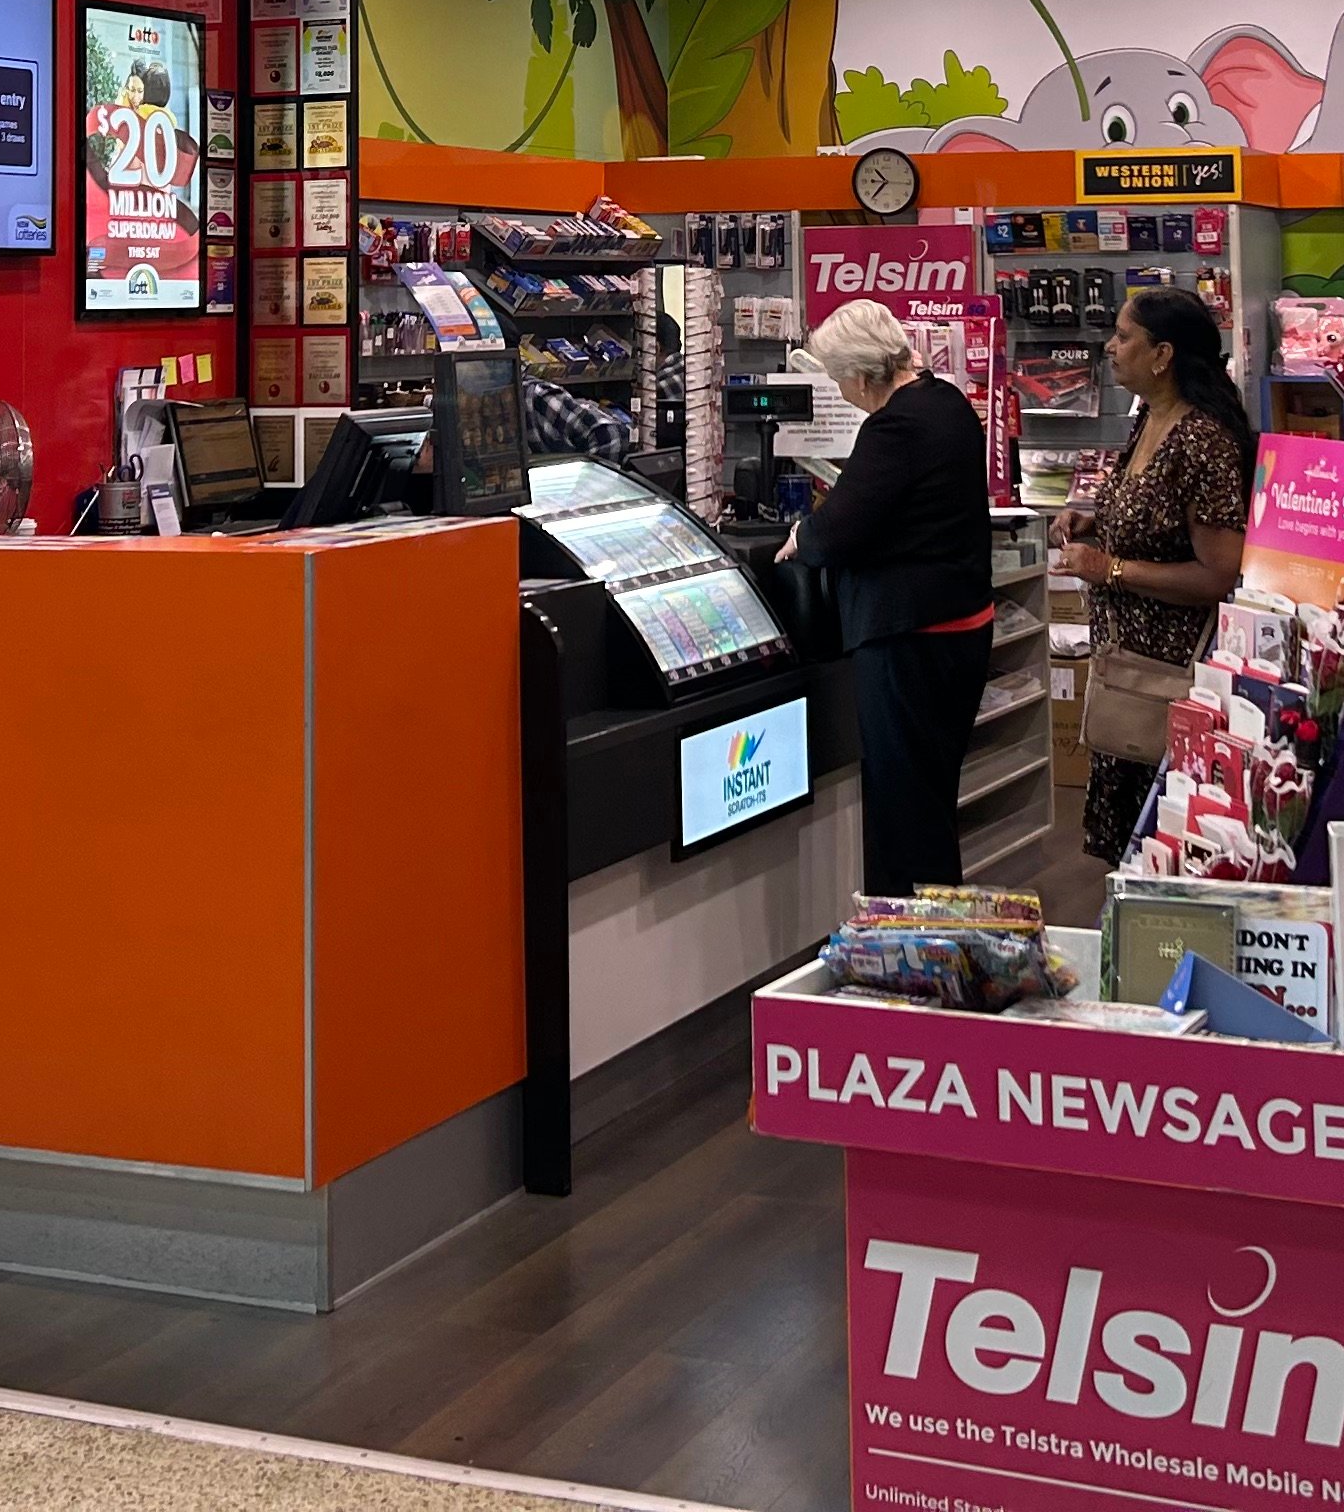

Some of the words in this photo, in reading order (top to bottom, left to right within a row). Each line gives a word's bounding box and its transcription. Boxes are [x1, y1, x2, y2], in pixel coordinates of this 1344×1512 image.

[128, 24, 161, 45] Lotto
[0, 92, 26, 110] entry
[1095, 164, 1174, 178] WESTERN
[1191, 160, 1223, 186] yes!
[1119, 176, 1174, 188] UNION
[108, 189, 177, 219] MILLION
[107, 221, 176, 239] SUPERDRAW
[128, 246, 145, 258] THIS
[146, 246, 161, 259] SAT
[810, 240, 967, 292] Telsim
[908, 296, 964, 316] Telsim
[1050, 349, 1089, 360] FOURS
[994, 385, 1005, 480] Telsim
[1271, 481, 1340, 519] Valentine's
[1278, 517, 1294, 532] Love
[723, 760, 771, 802] INSTANT
[1241, 929, 1310, 952] DON'T
[1291, 961, 1317, 979] IN
[765, 1045, 978, 1120] PLAZA
[865, 1403, 903, 1428] We
[908, 1414, 950, 1436] use
[956, 1417, 995, 1444] the
[1001, 1425, 1084, 1459] Telstra
[1089, 1439, 1220, 1481] Wholesale
[1226, 1462, 1314, 1499] Mobile
[865, 1482, 950, 1512] Unlimited
